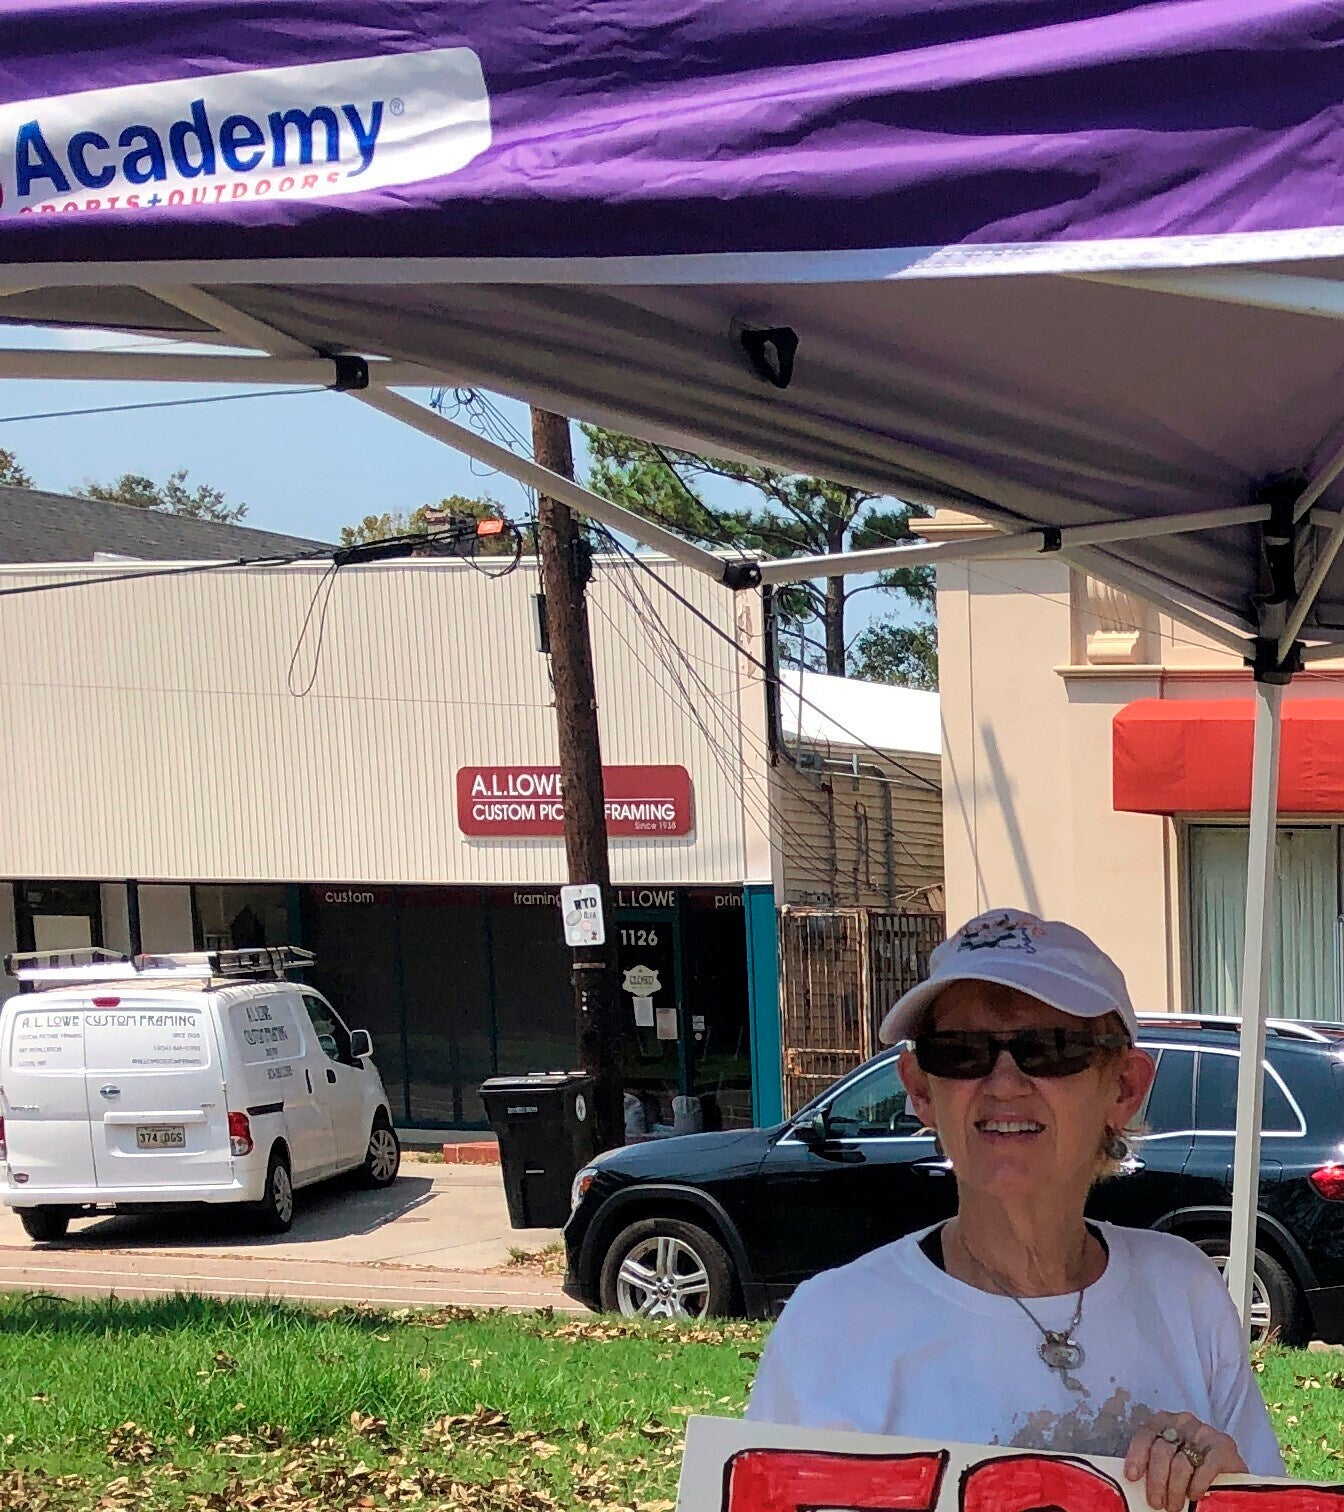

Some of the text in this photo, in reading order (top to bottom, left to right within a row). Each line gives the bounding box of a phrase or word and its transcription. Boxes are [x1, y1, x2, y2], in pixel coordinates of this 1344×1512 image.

[16, 98, 384, 197] Academy
[472, 804, 536, 821] CUSTOM
[603, 803, 676, 821] FRAMING
[634, 821, 657, 830] Since
[325, 890, 375, 904] custom
[620, 929, 659, 946] 1126
[47, 1016, 79, 1027] LOWE
[85, 1015, 137, 1027] CUSTOM
[140, 1015, 196, 1027] FRAMING
[139, 1133, 158, 1143] 374
